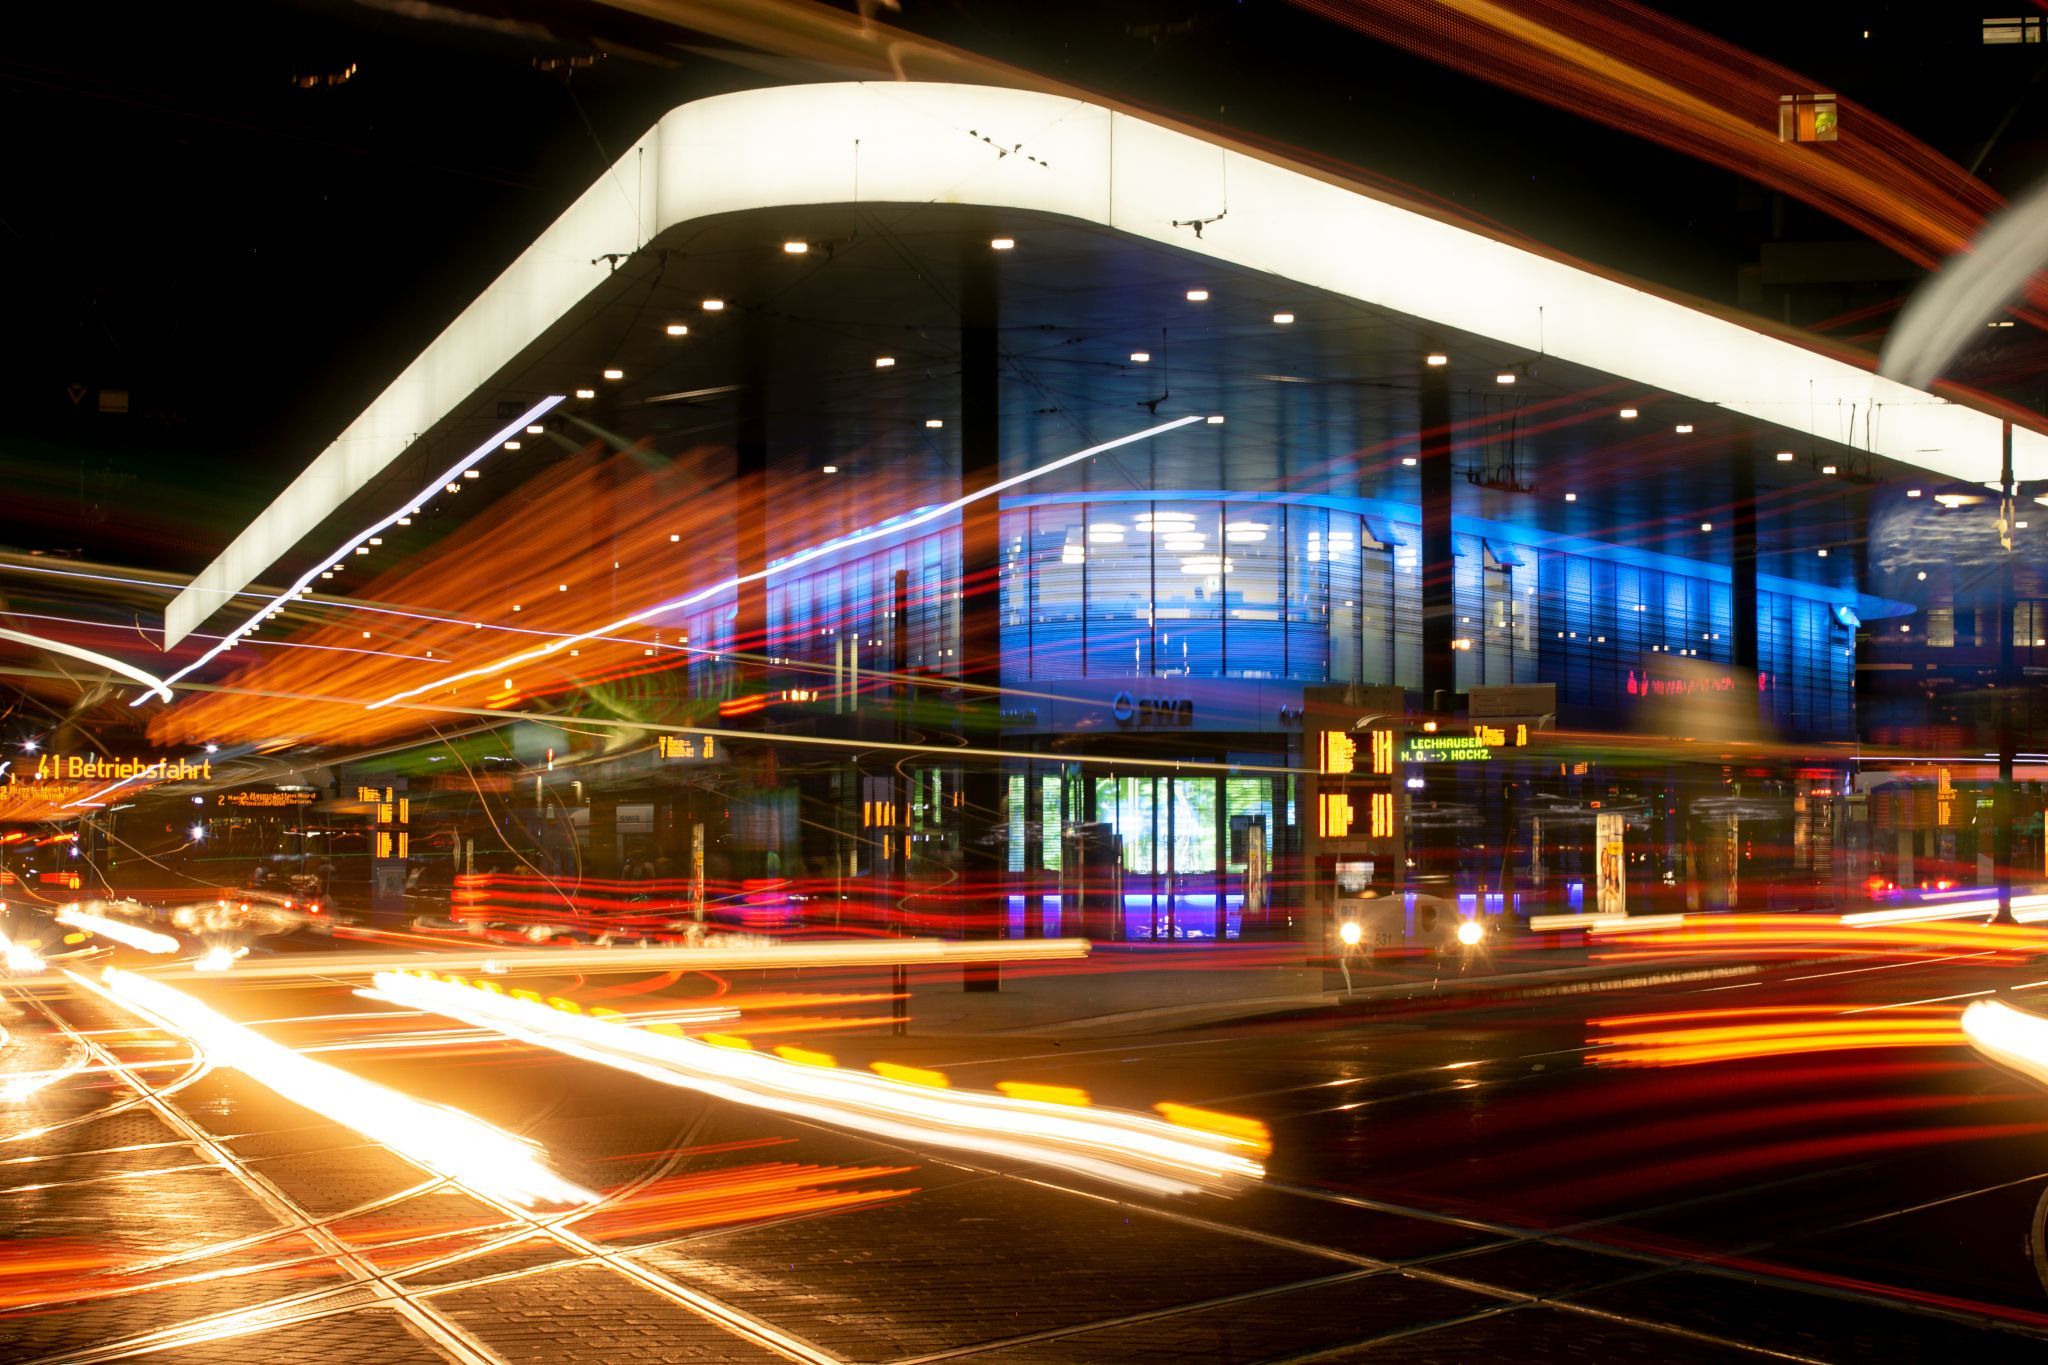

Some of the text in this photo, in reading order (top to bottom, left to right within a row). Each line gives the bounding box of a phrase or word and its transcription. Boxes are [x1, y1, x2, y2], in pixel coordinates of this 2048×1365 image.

[1411, 737, 1483, 750] LECHHAUSEN
[1451, 749, 1492, 760] HOCHZ.
[38, 754, 212, 780] 41 Betriebsfahrt
